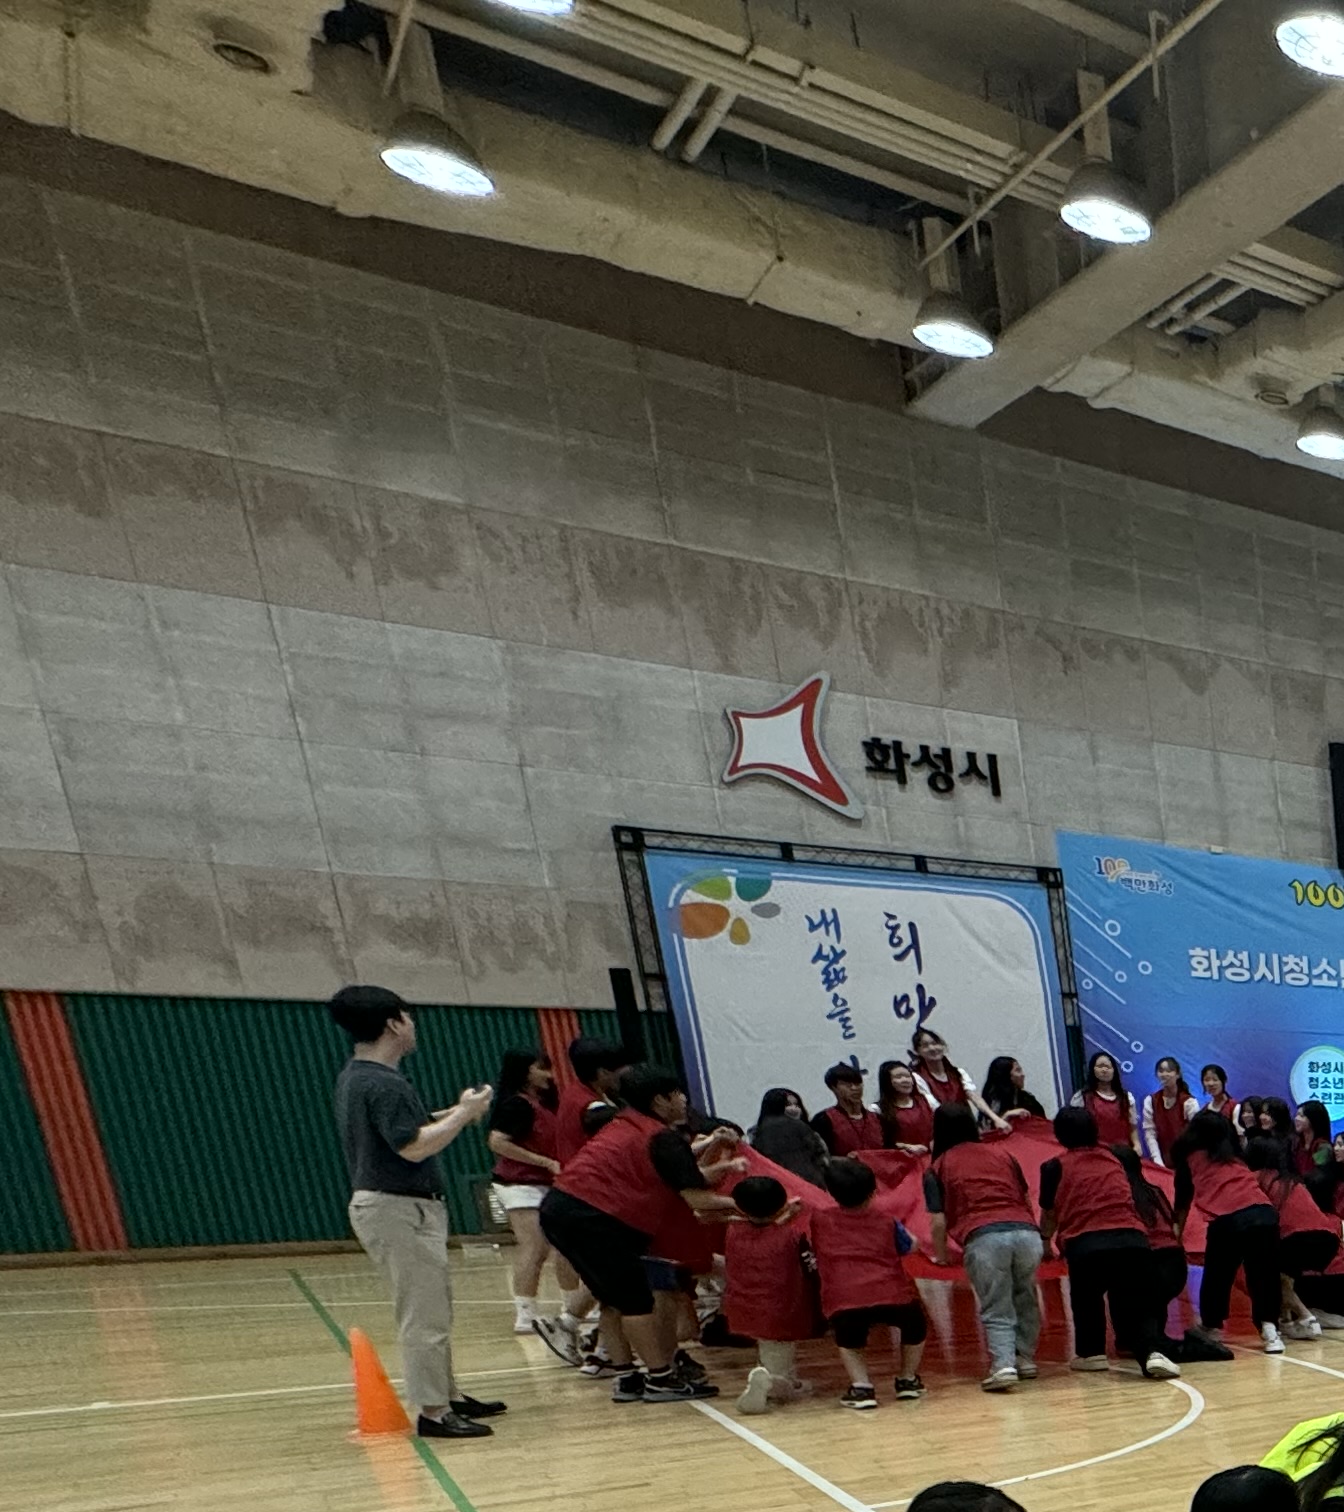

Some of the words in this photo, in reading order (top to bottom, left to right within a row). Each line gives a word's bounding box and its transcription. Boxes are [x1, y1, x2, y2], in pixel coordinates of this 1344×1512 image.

[861, 737, 1002, 798] 화성시
[1120, 877, 1174, 896] 백만화성
[1307, 1061, 1344, 1075] 화성시
[1308, 1076, 1344, 1090] 청소년
